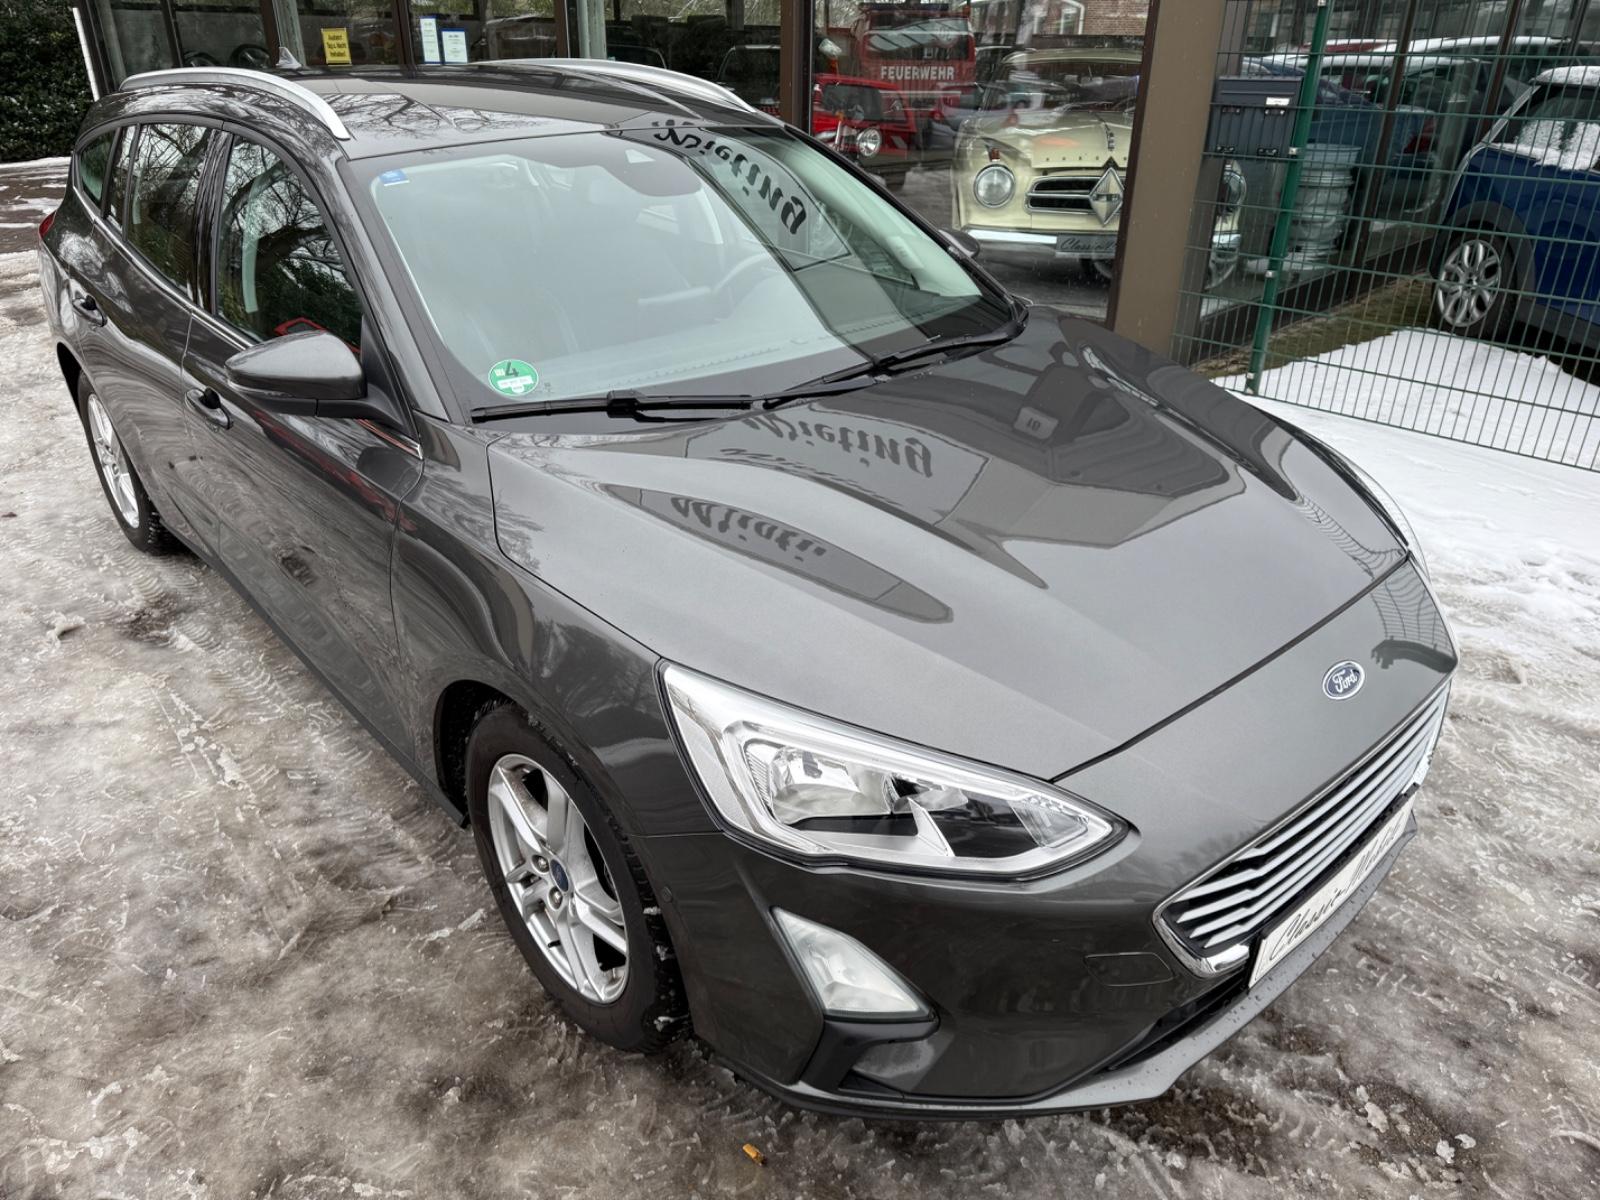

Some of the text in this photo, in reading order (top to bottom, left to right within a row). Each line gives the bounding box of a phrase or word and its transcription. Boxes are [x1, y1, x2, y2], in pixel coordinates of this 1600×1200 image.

[880, 65, 955, 80] FEUERWEHR
[505, 361, 519, 377] 4
[1332, 669, 1357, 693] Ford
[1269, 887, 1346, 961] Classic
